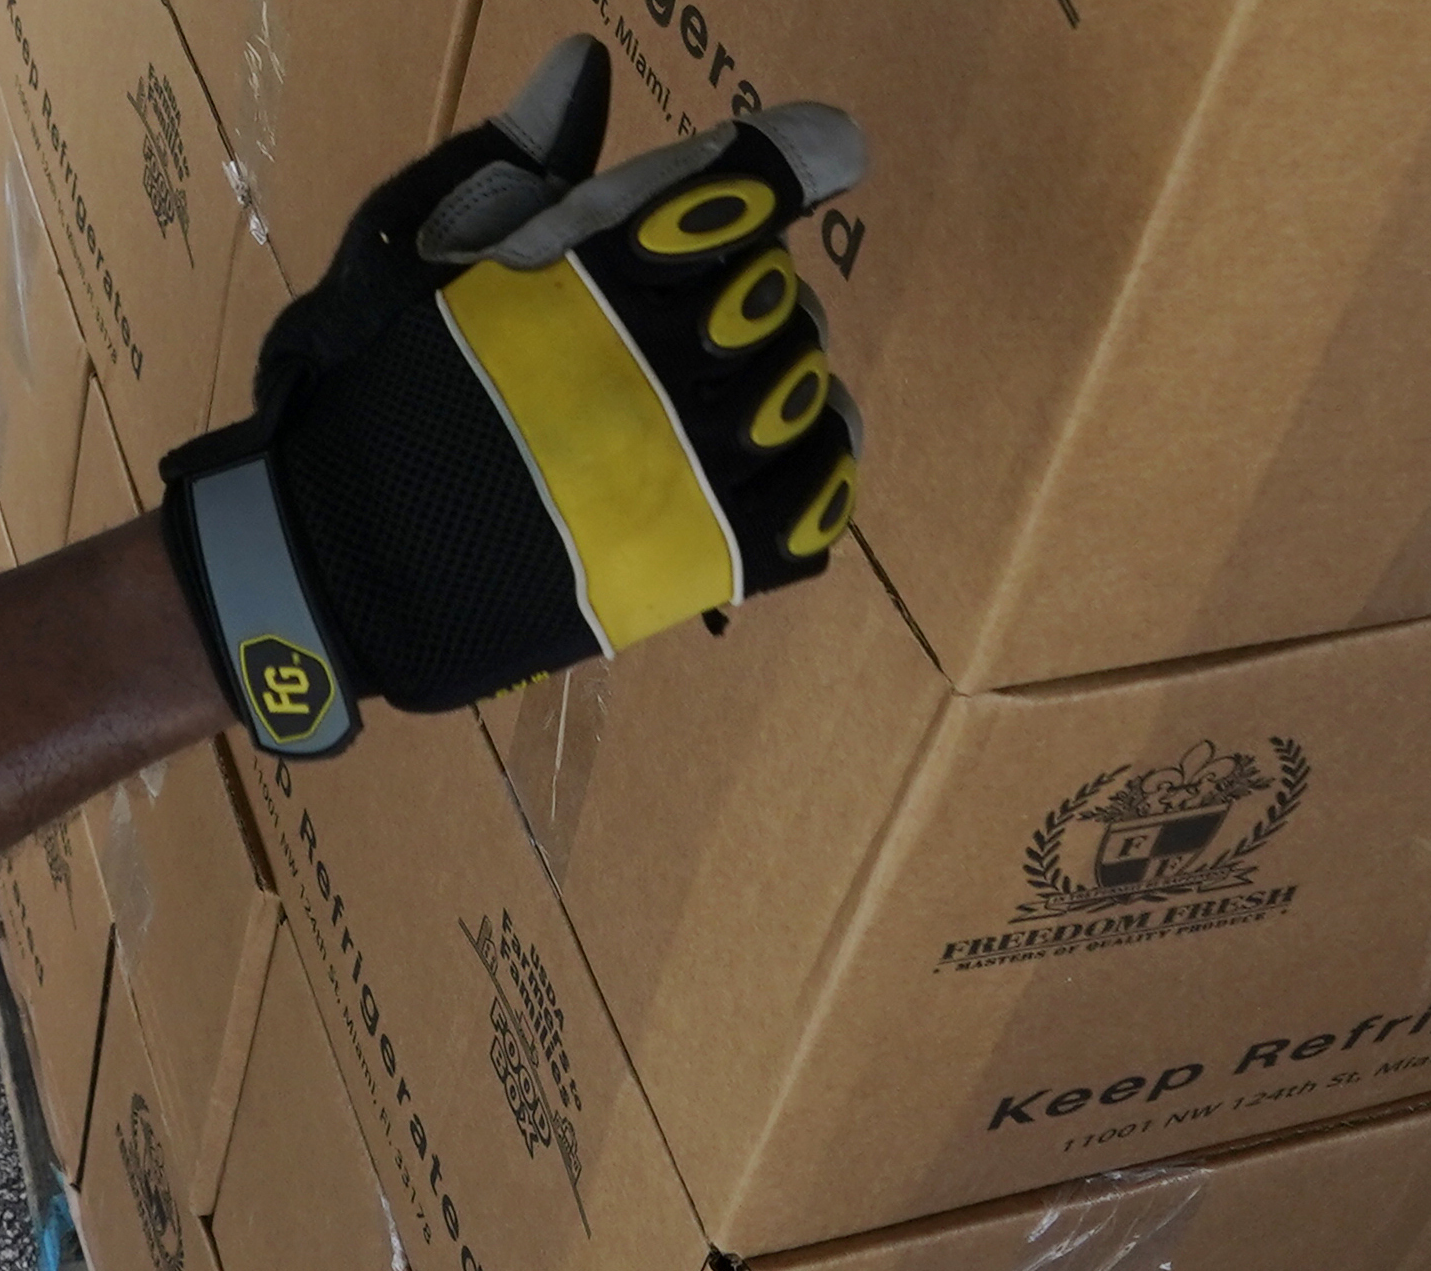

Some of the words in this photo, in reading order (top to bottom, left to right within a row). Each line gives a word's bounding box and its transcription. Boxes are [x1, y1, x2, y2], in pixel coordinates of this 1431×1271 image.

[615, 14, 674, 123] Miami,
[42, 89, 144, 380] Refrigerated
[1119, 834, 1150, 858] F
[942, 912, 1155, 959] FREEDOM
[1162, 885, 1298, 927] FRESH
[954, 950, 1046, 972] MASTERS
[1052, 945, 1078, 957] OF
[1085, 929, 1173, 953] QUALITY
[1176, 913, 1266, 937] PRODUCE
[500, 934, 570, 1108] Families
[502, 907, 570, 1073] Farmers
[569, 1077, 582, 1111] to
[530, 942, 564, 1032] USDA
[490, 995, 552, 1148] FOOD
[490, 1035, 540, 1160] BOX
[987, 1062, 1207, 1131] Keep
[1062, 1118, 1153, 1153] 11001
[1164, 1101, 1224, 1128] NW
[1232, 1081, 1317, 1112] 124th
